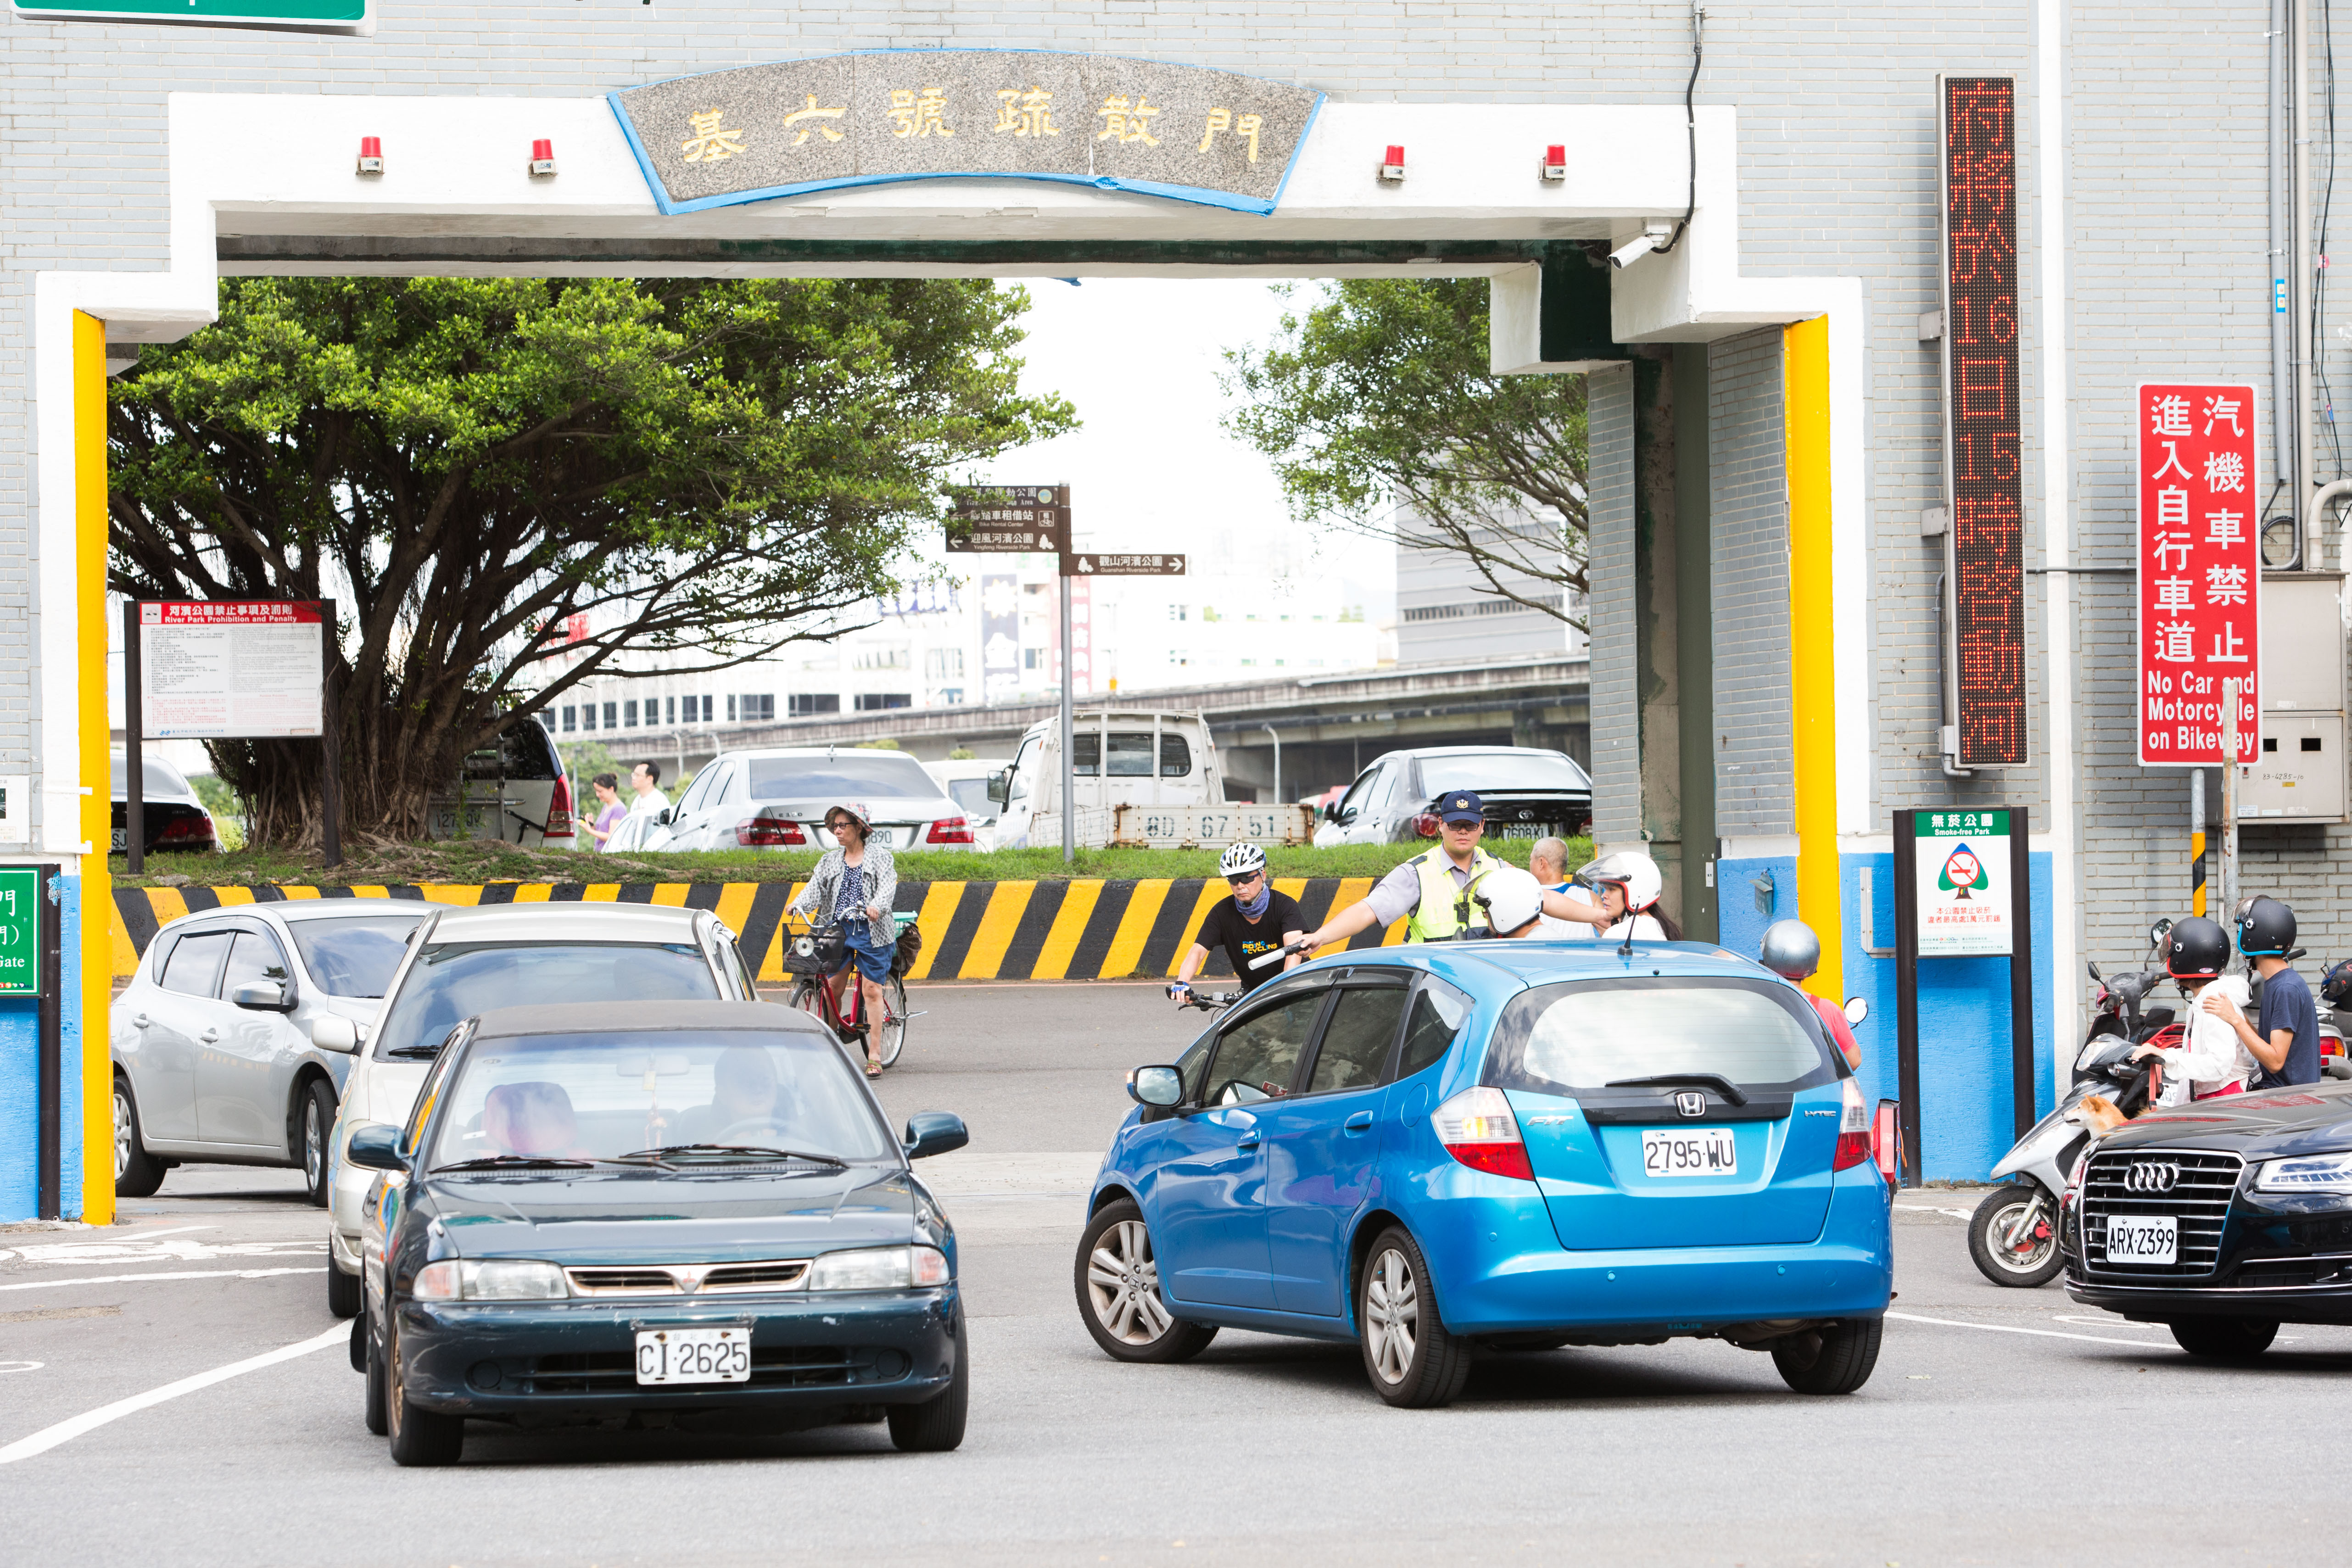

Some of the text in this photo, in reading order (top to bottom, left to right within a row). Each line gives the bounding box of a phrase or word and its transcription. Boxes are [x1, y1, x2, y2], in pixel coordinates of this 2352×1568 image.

[682, 86, 1262, 163] 基六號疏散門
[2151, 395, 2196, 662] 進入自行車道
[2202, 395, 2248, 662] 汽機車禁止
[971, 533, 1034, 544] 迎風河濱公園
[1099, 555, 1162, 566] 觀山河濱公園
[169, 605, 292, 616] 河濱公園禁止事項及罰則
[2148, 670, 2254, 693] No Car nd
[2148, 697, 2254, 726] Motorcyle
[2149, 732, 2169, 749] on
[1201, 816, 1229, 837] 67
[1249, 815, 1274, 837] 51
[1931, 814, 1993, 827] 無菸公園
[1936, 906, 1991, 915] 本公園禁止吸菸
[1247, 943, 1278, 954] CYCLING
